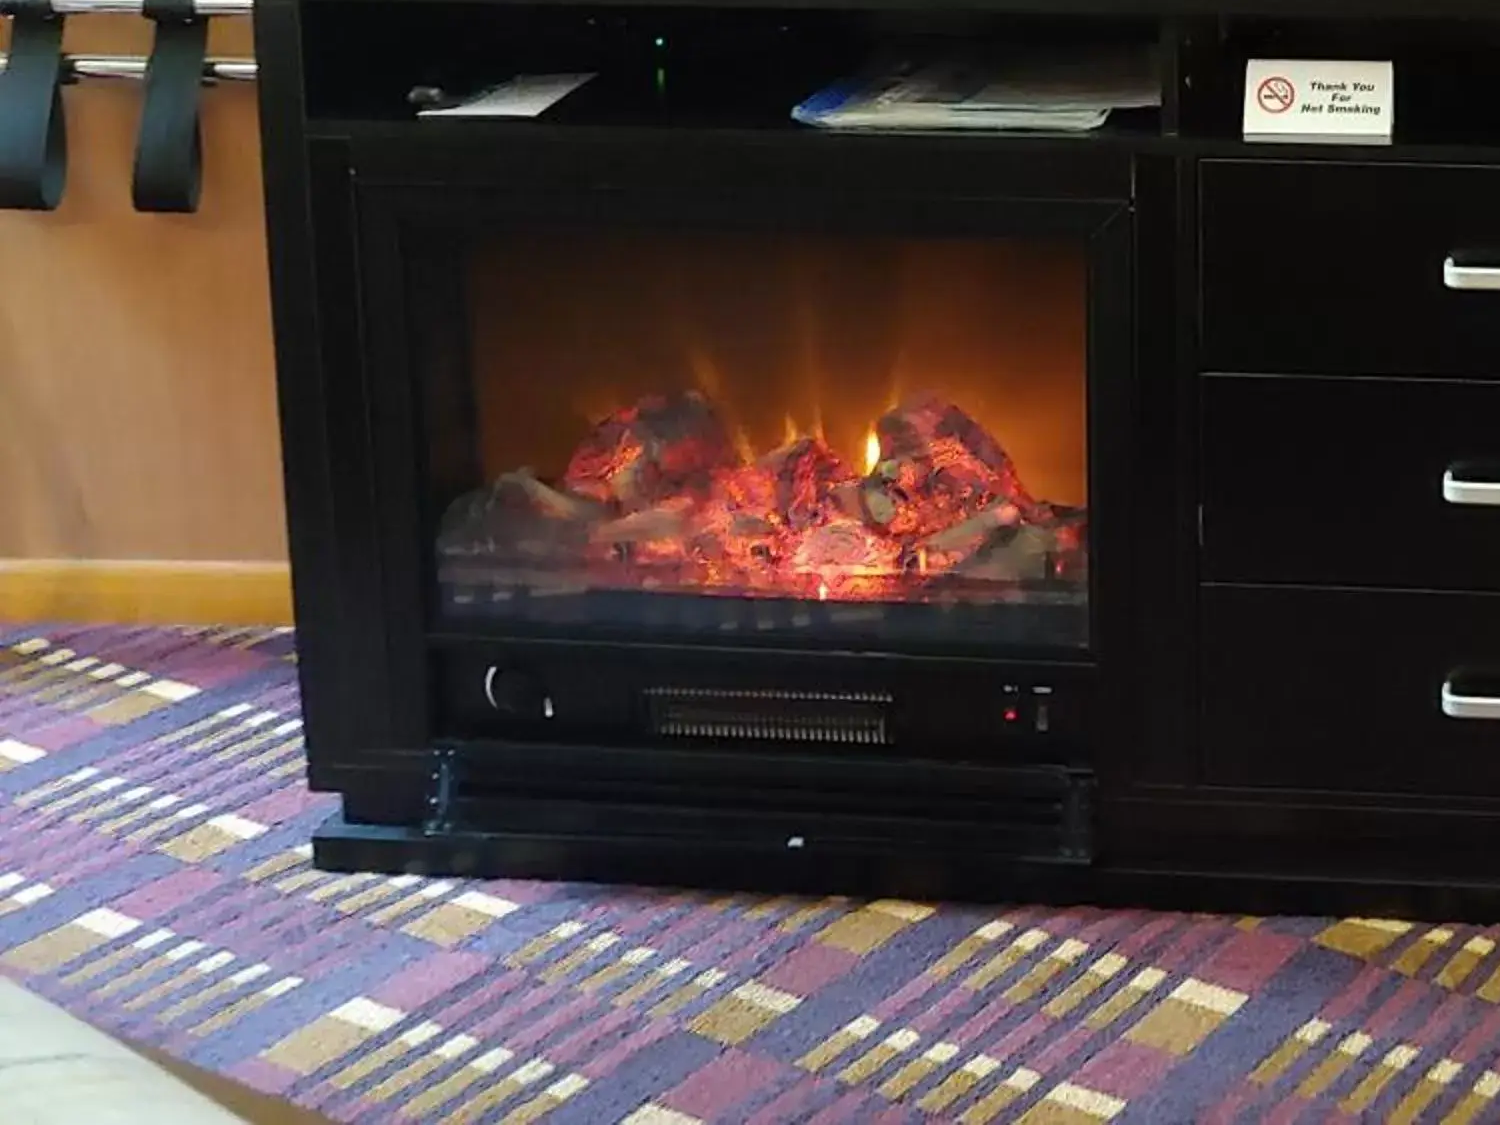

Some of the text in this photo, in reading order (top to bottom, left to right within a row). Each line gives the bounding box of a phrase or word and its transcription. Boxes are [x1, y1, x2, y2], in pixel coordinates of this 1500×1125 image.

[1310, 82, 1375, 92] Thank You
[1331, 93, 1352, 102] For
[1301, 104, 1381, 116] Not Smoking
